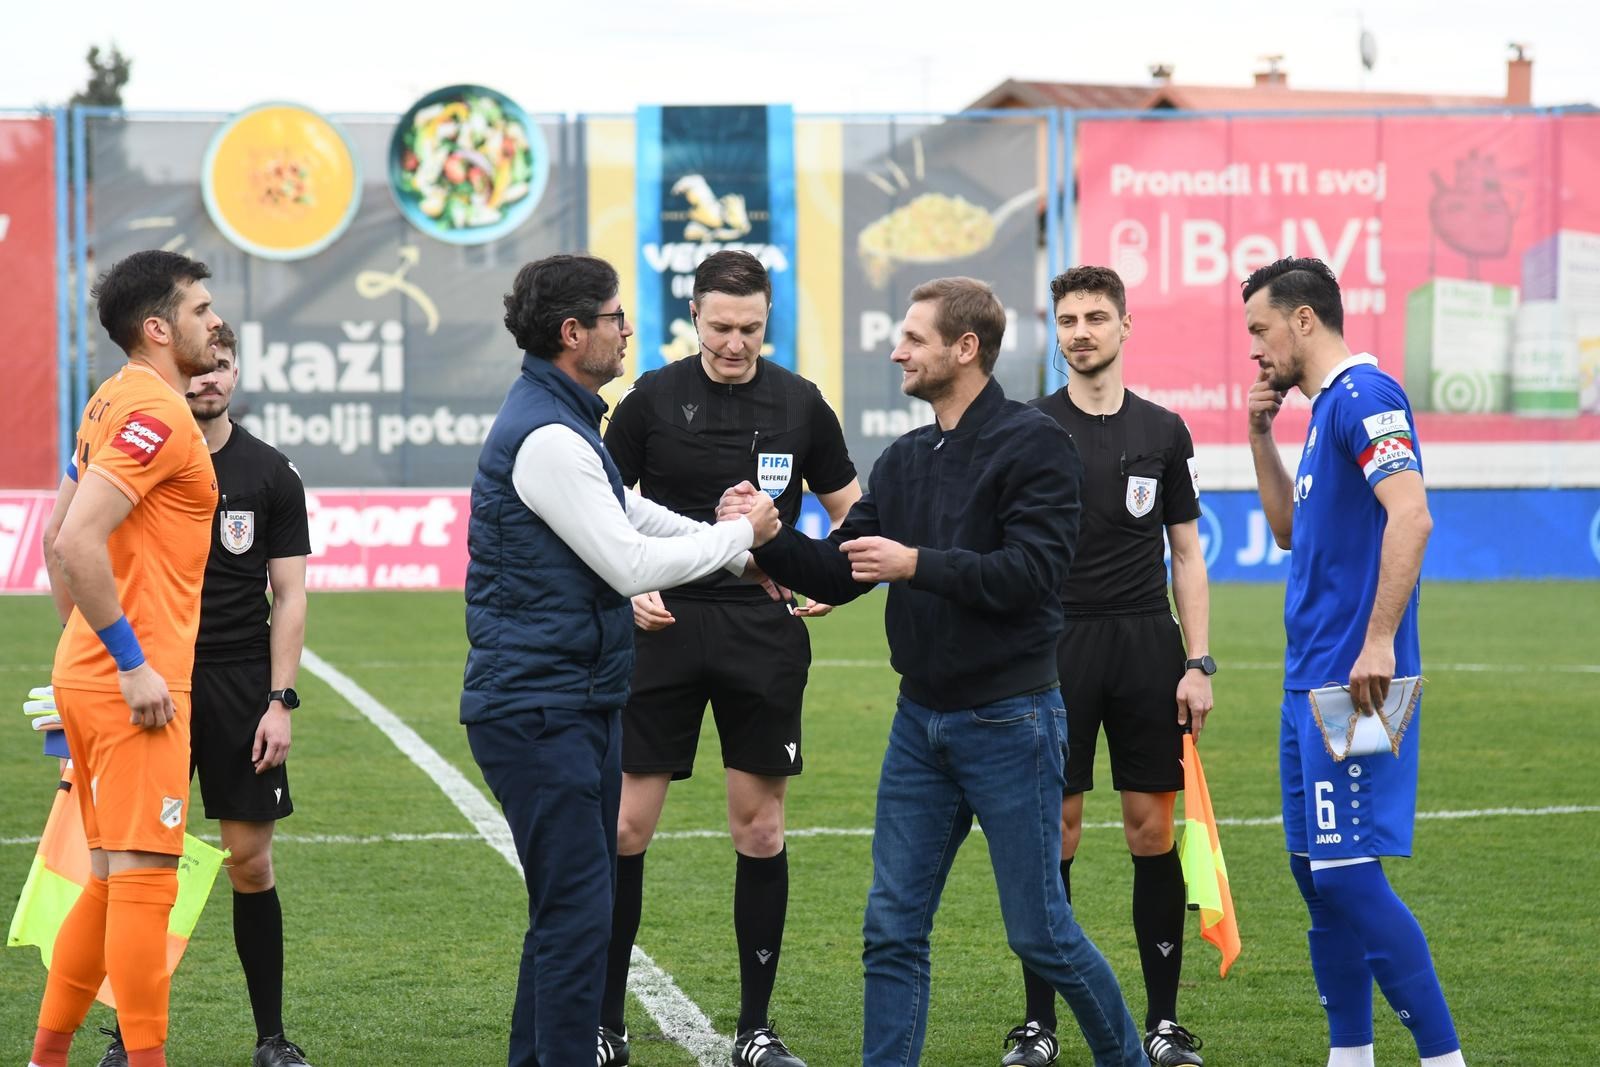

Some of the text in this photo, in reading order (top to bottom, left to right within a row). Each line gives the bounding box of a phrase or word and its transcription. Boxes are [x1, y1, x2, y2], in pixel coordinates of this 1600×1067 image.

[1259, 163, 1272, 194] i
[1276, 163, 1308, 195] Ti
[1316, 163, 1388, 201] svoj
[240, 321, 405, 393] kaži
[125, 421, 164, 443] Super
[241, 403, 373, 455] ajbolji
[121, 430, 156, 454] Sport
[761, 457, 789, 468] FIFA
[1377, 450, 1407, 465] SLAVEN
[1314, 780, 1337, 830] 6
[1316, 833, 1342, 845] JAKO
